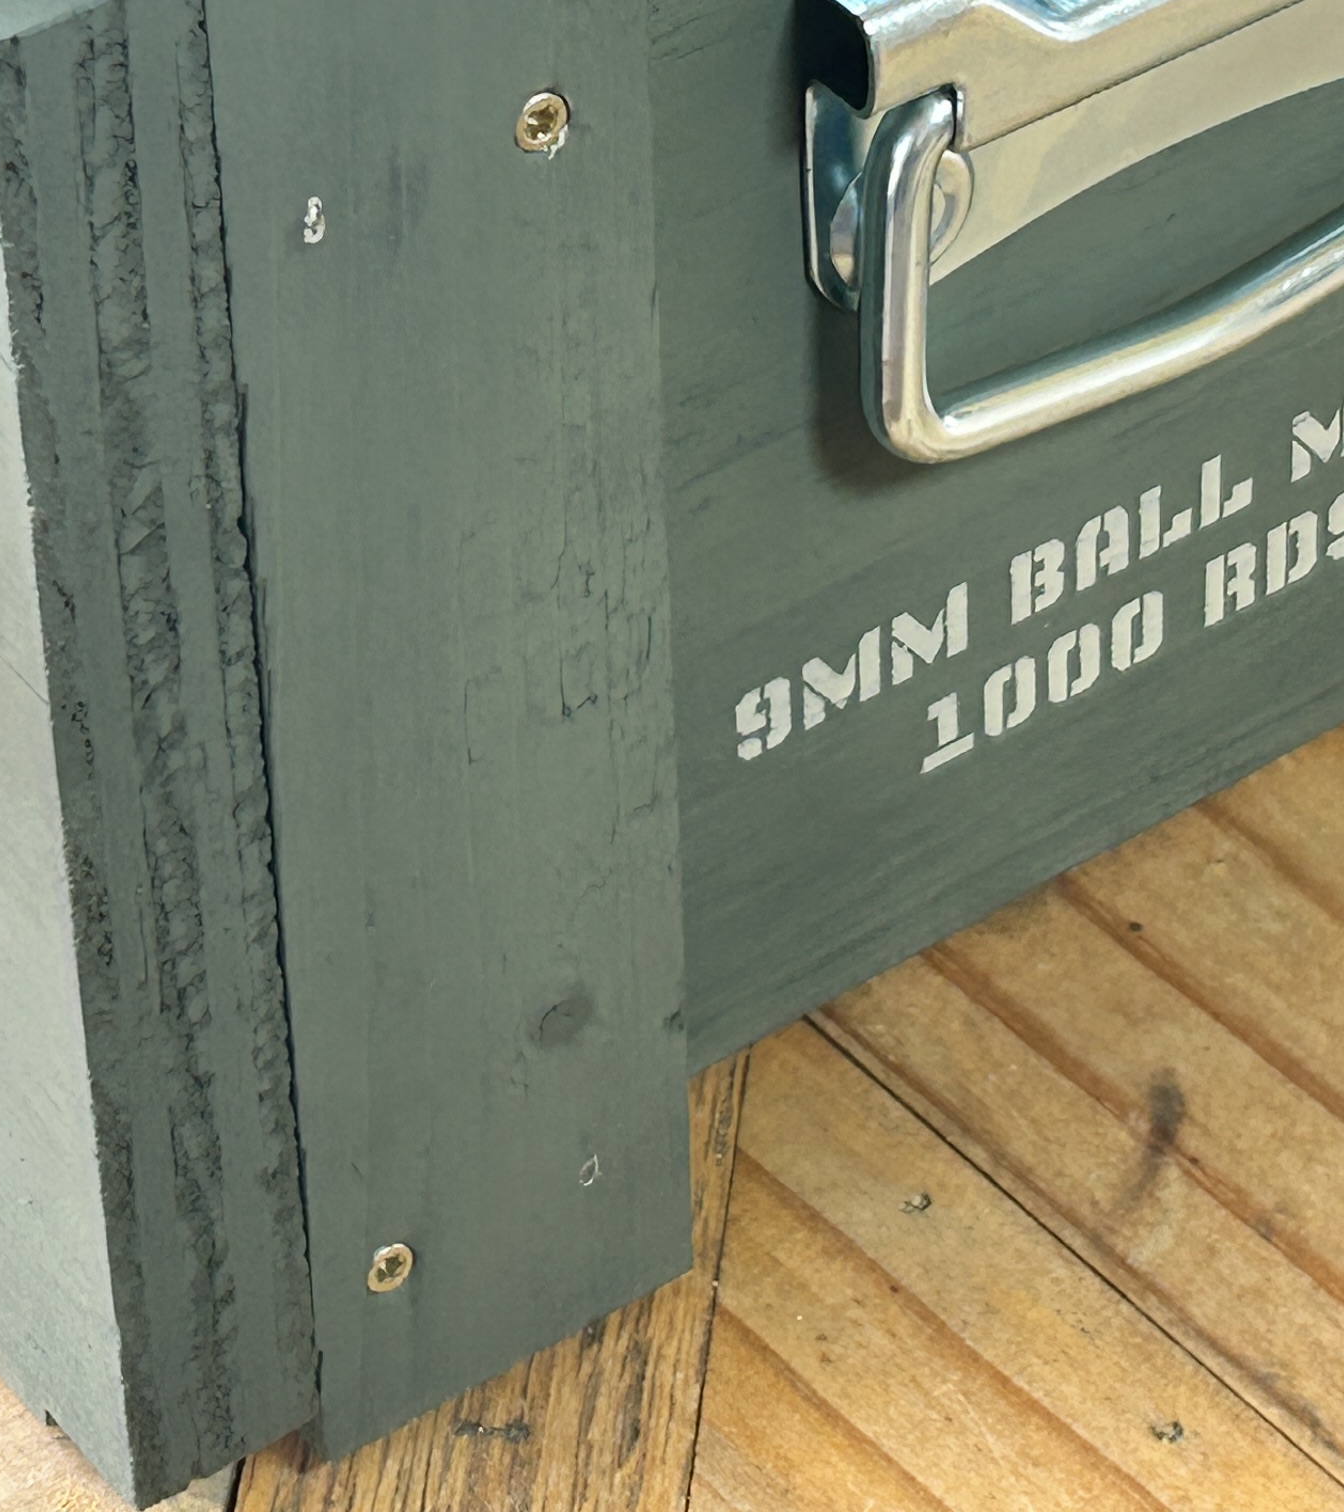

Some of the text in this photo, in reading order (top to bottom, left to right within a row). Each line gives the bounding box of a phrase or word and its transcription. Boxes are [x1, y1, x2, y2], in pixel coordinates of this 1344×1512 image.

[734, 582, 968, 762] 9MM
[1009, 453, 1254, 626] BALL
[919, 590, 1164, 774] 1000
